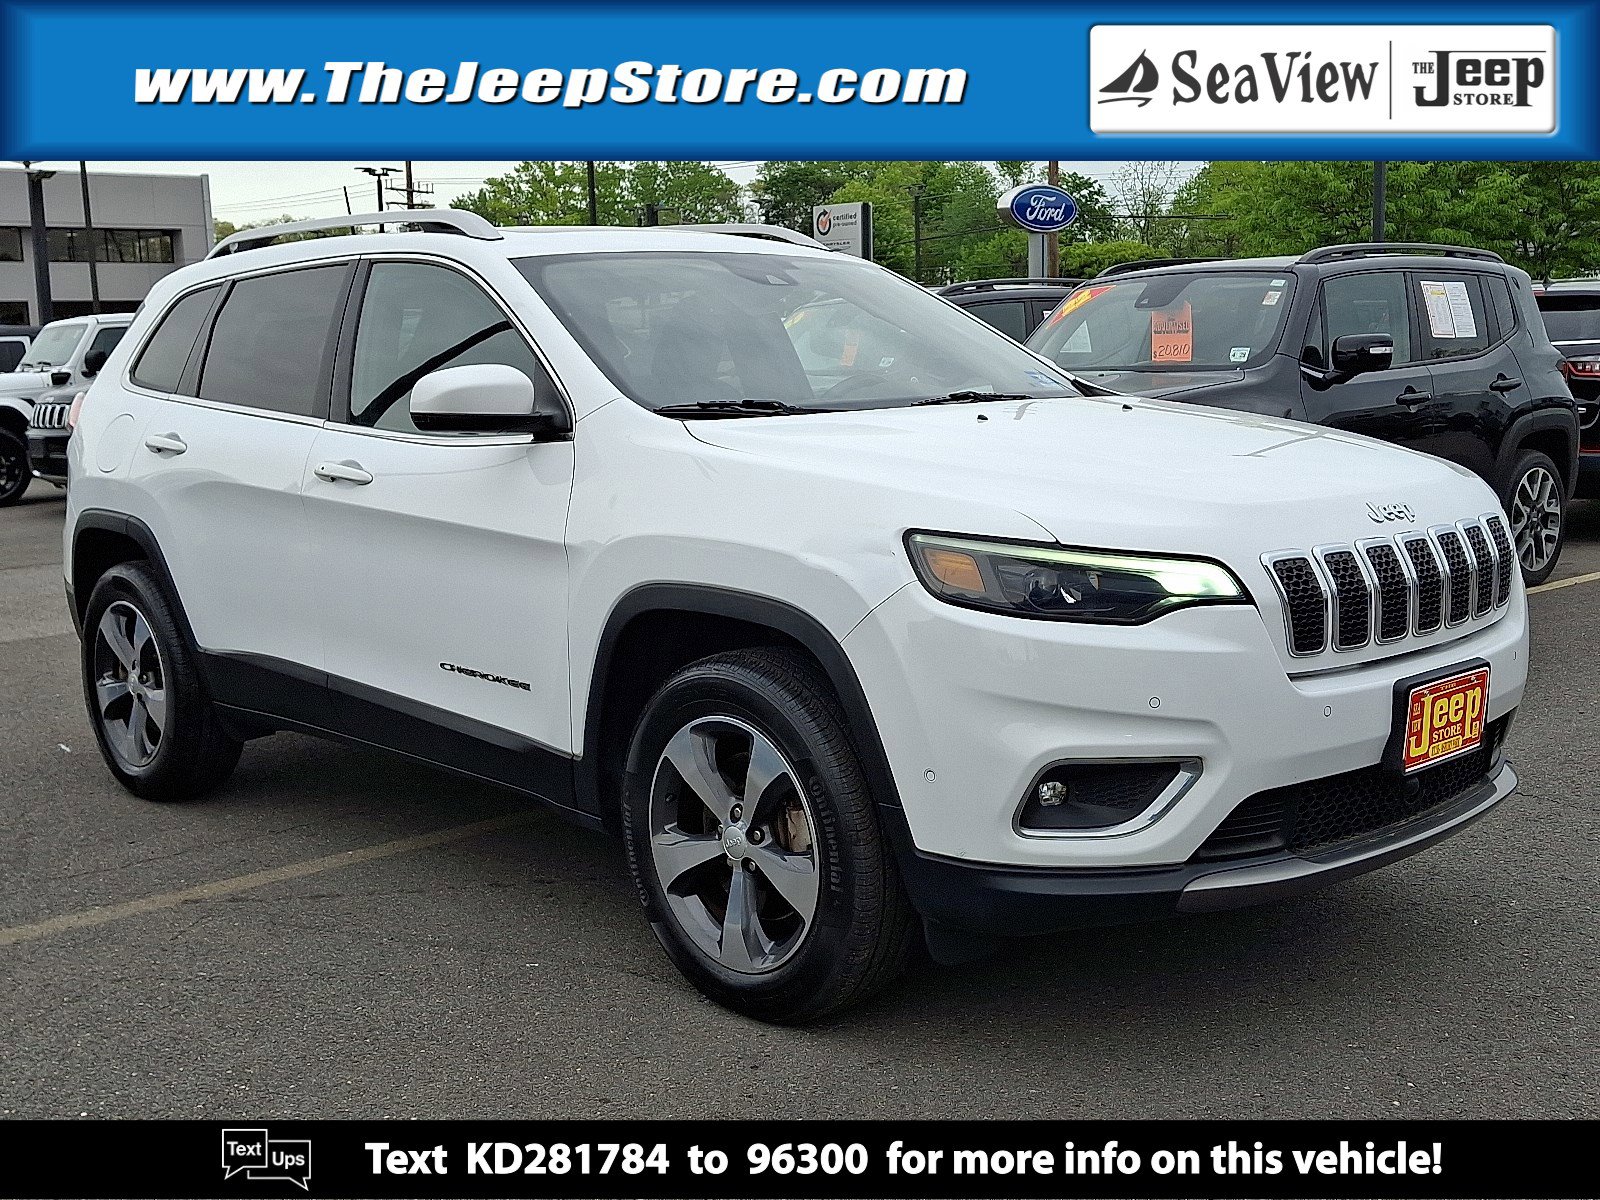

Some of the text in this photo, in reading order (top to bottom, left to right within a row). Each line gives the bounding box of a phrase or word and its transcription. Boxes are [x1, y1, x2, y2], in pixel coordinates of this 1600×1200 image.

[832, 213, 857, 221] certified
[1025, 194, 1066, 222] Ford
[1366, 500, 1416, 524] Jeep
[440, 662, 531, 692] CHEROKEE
[1409, 686, 1482, 758] Jeep
[1433, 723, 1463, 743] STORE
